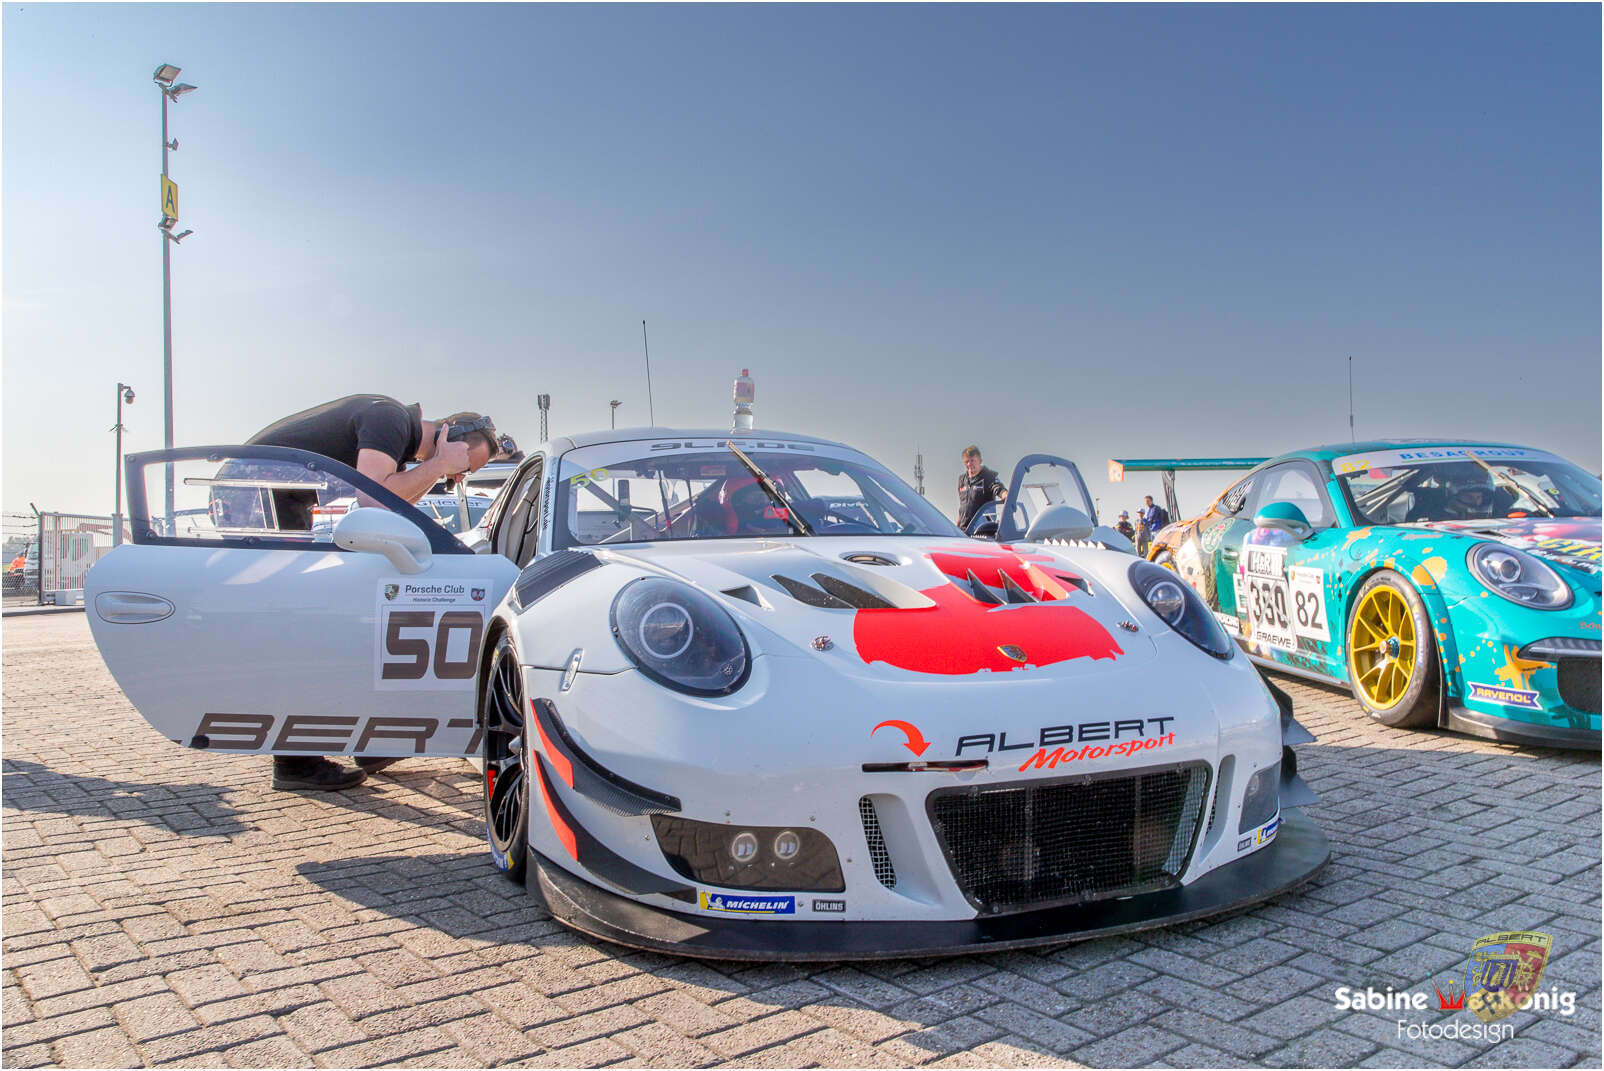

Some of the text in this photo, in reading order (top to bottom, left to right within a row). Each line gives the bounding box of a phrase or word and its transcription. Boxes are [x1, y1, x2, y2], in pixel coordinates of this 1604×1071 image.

[166, 185, 175, 214] A
[405, 585, 465, 594] Porsche Club
[1296, 590, 1323, 629] 82
[382, 611, 484, 680] 50
[1256, 631, 1291, 649] GRAEWE
[1476, 687, 1531, 704] RAVENOL
[174, 712, 484, 754] BERT
[955, 716, 1175, 756] ALBERT
[1018, 732, 1176, 772] Motorsport
[726, 900, 789, 910] MICHELIN
[815, 901, 843, 911] ÖHLINS
